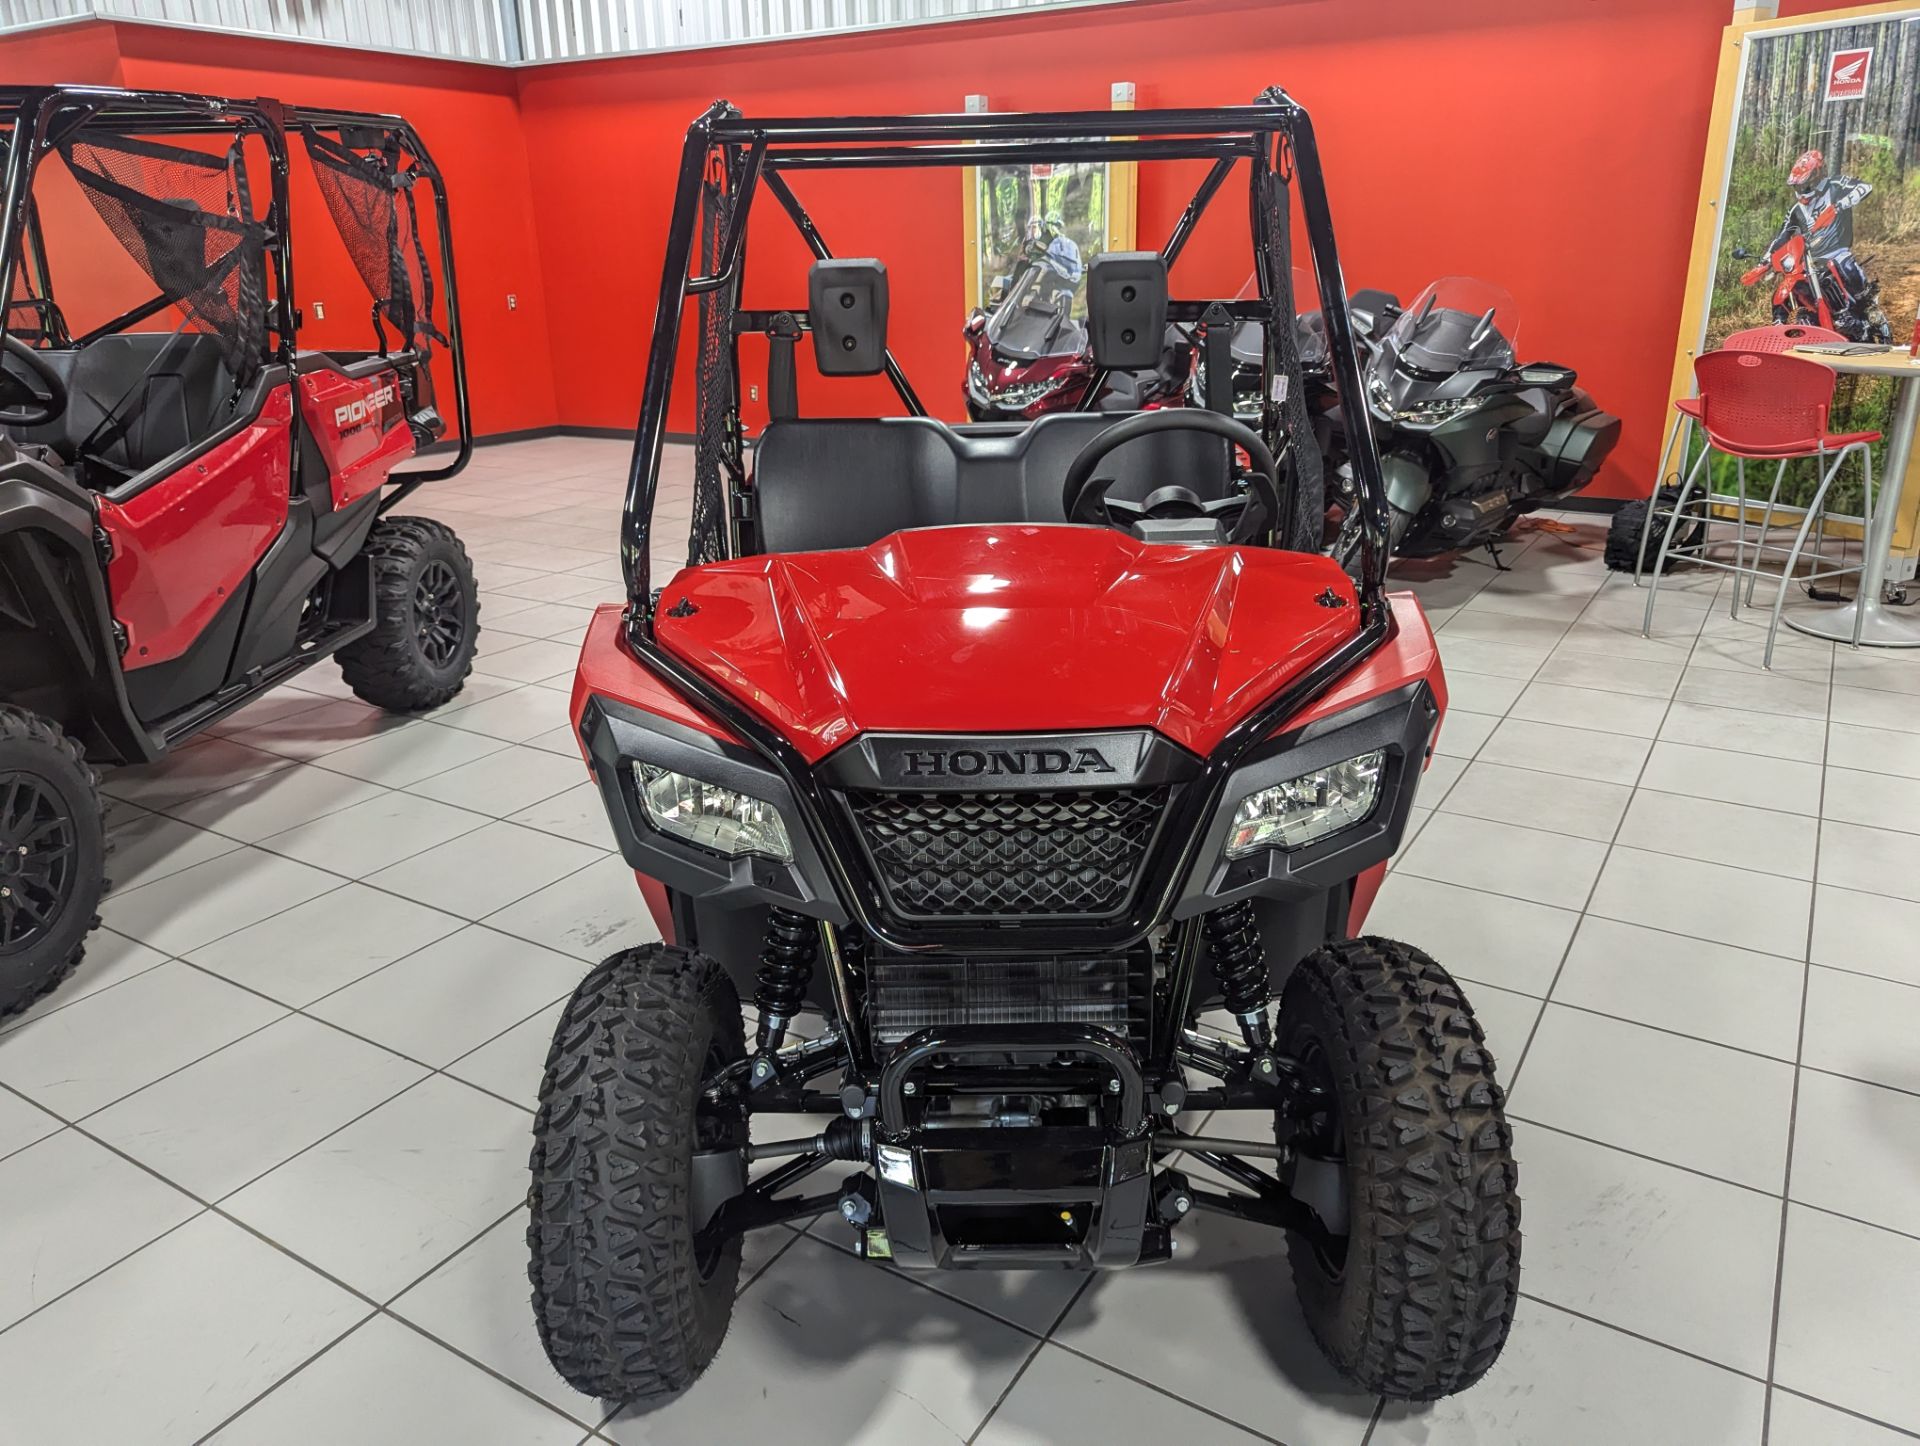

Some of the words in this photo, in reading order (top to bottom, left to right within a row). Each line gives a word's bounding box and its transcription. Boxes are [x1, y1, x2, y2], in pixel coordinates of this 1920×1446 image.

[1833, 77, 1862, 85] HONDA
[335, 385, 394, 427] PIONEER
[339, 425, 362, 440] 1000
[903, 748, 1116, 776] HONDA
